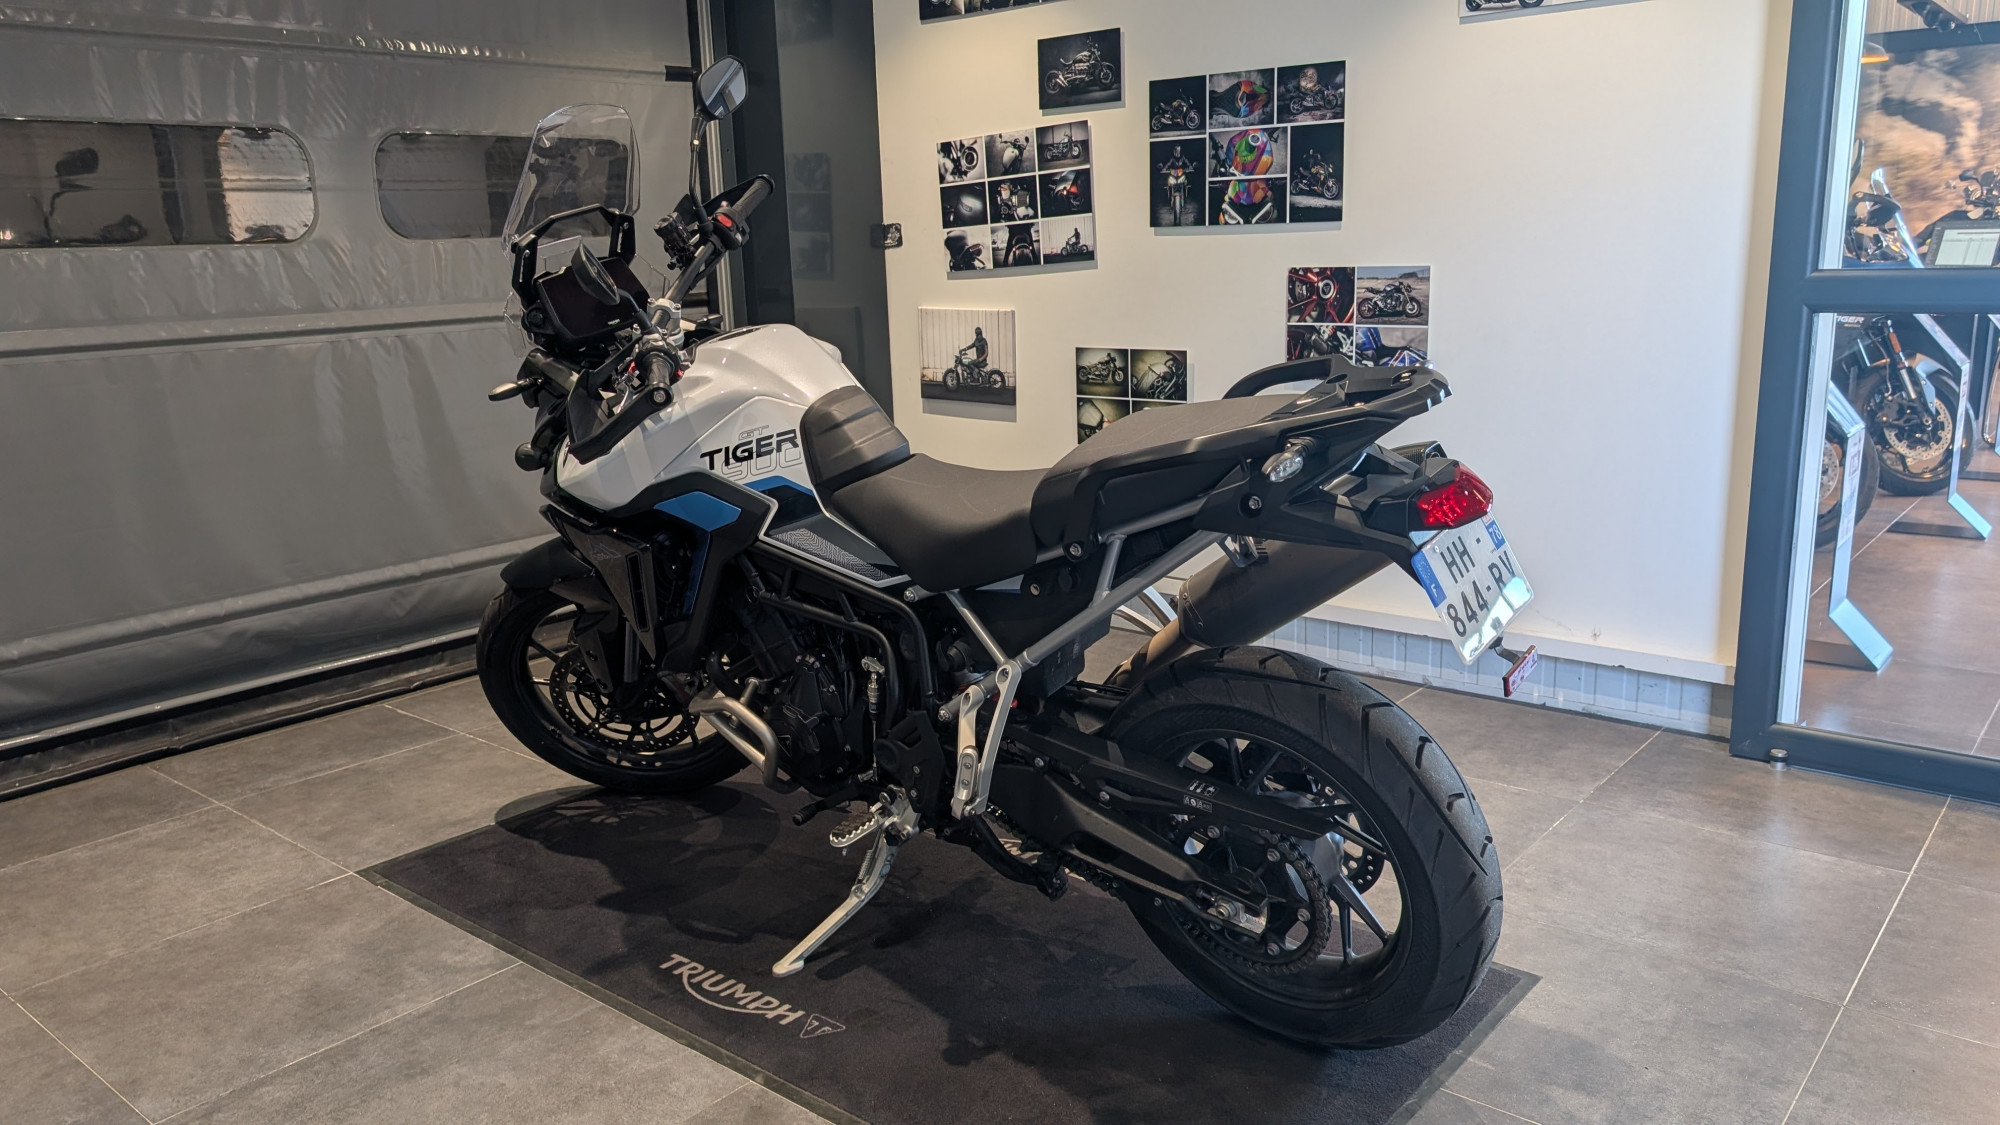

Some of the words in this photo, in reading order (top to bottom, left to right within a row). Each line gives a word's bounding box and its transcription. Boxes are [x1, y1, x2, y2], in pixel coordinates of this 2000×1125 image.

[700, 429, 799, 470] TIGER
[739, 425, 769, 440] GT
[1488, 524, 1502, 544] 78
[1440, 536, 1476, 584] HH
[1430, 583, 1438, 598] F
[1446, 550, 1516, 637] 844-RV
[659, 953, 806, 1026] TRIUMPH
